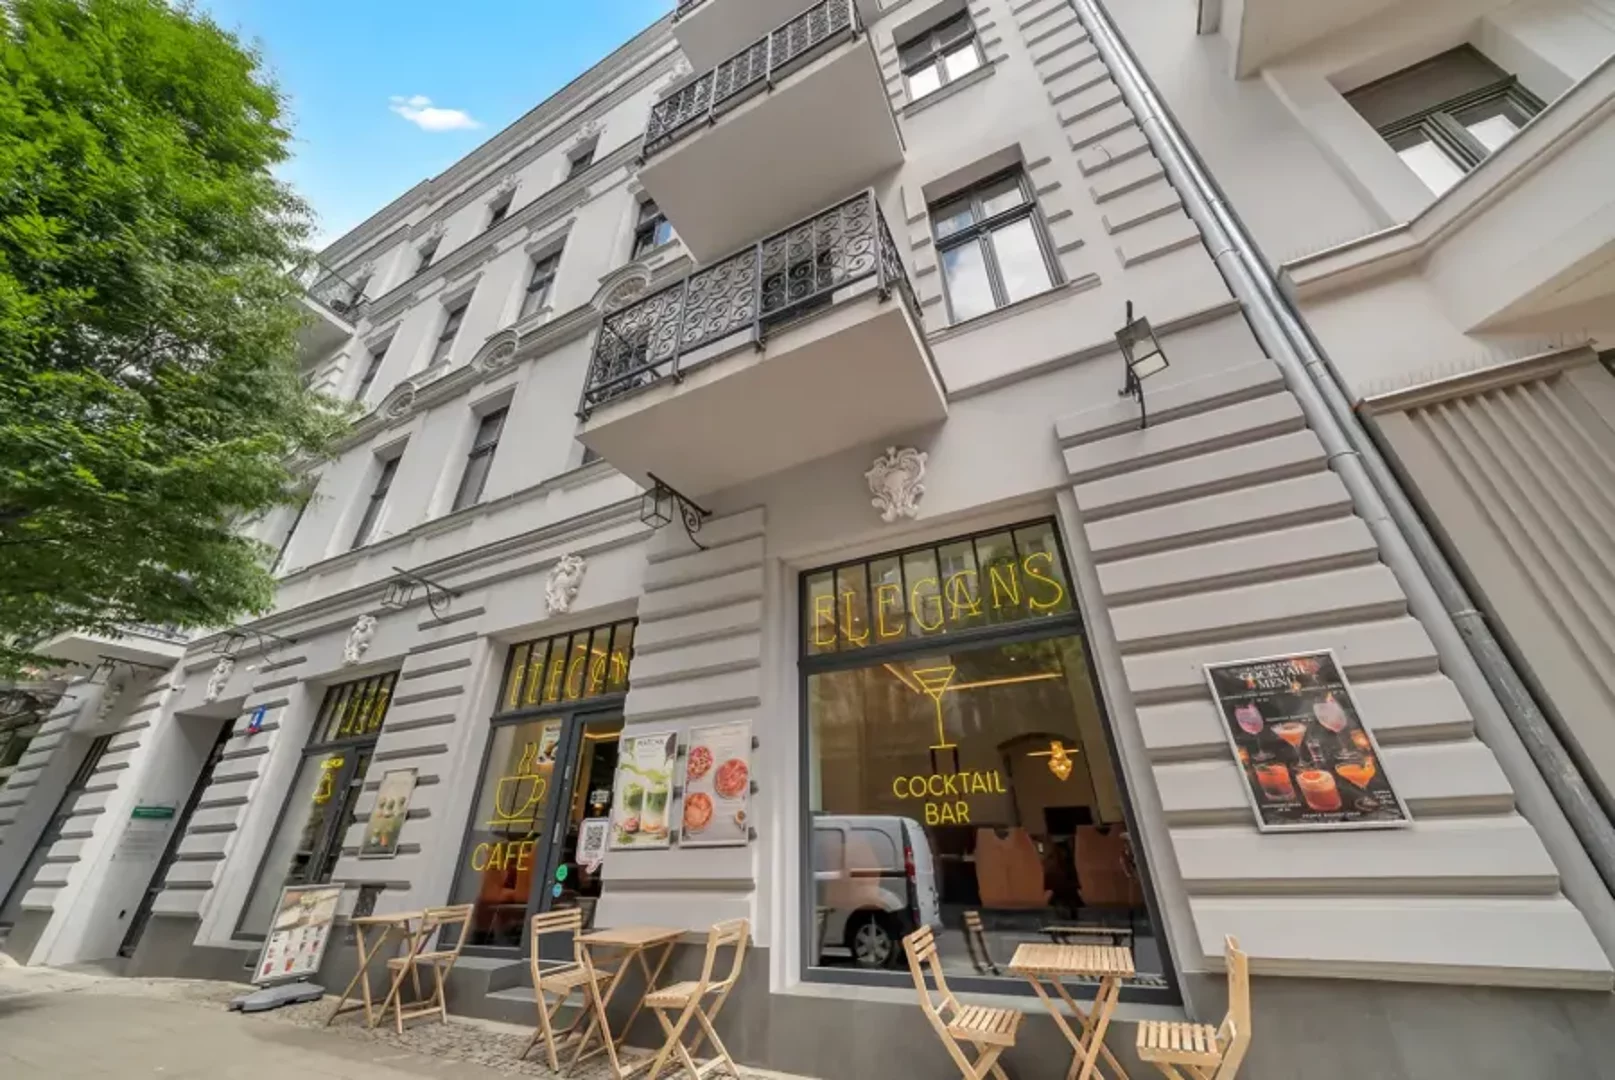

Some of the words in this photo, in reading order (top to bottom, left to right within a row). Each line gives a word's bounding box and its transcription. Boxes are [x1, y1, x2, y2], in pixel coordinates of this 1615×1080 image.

[814, 551, 1064, 647] ELEGANS
[892, 769, 1008, 799] COCKTAIL
[924, 801, 970, 826] BAR
[471, 830, 536, 872] CAFÉ
